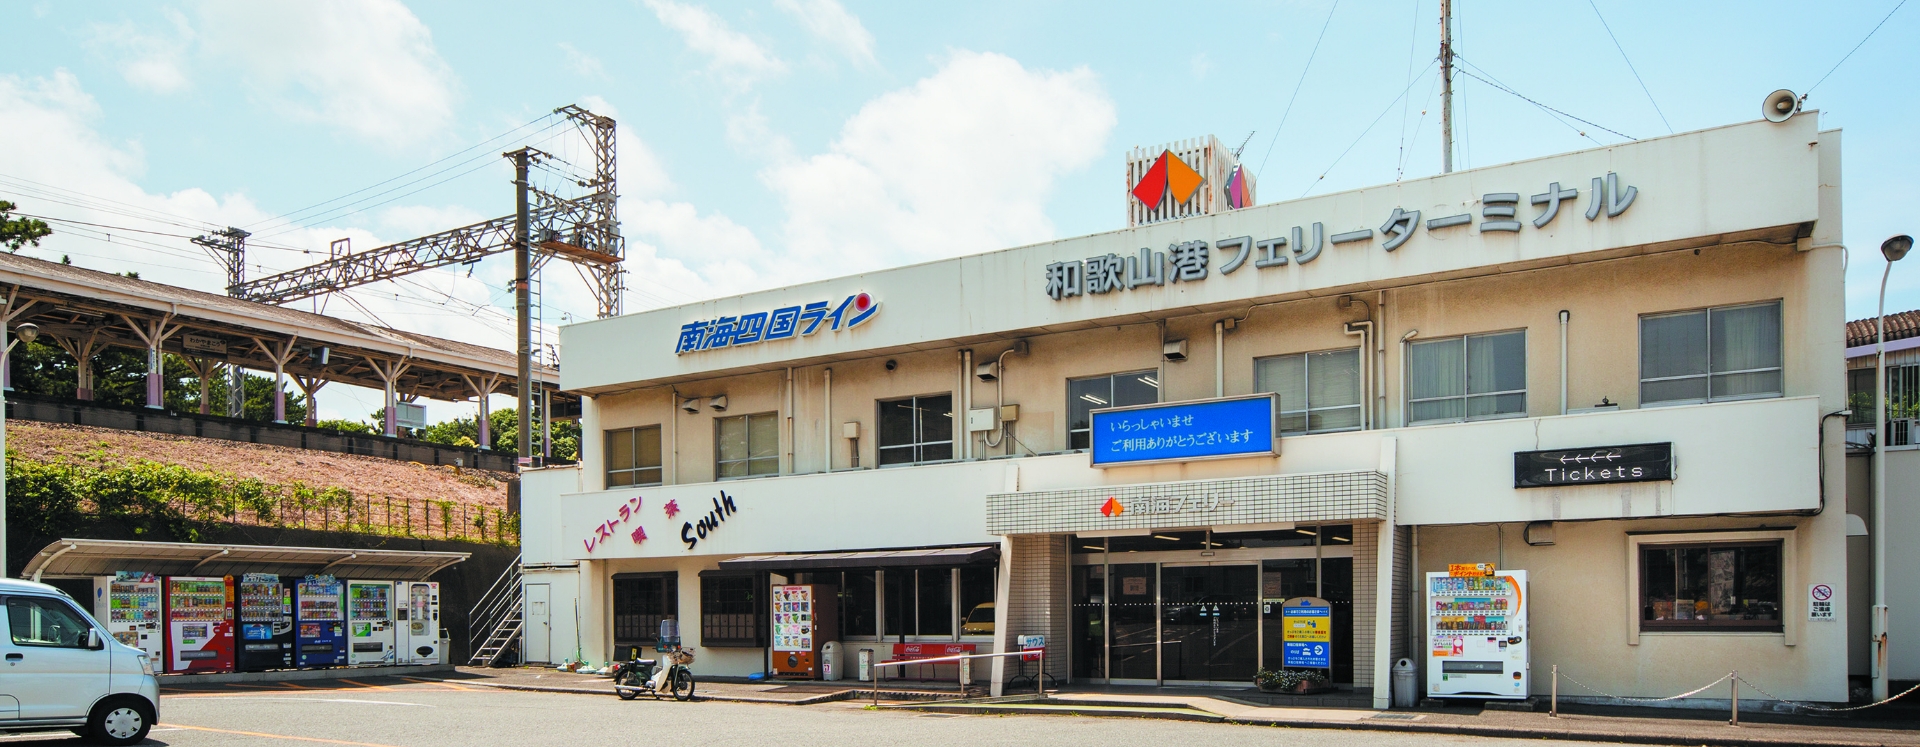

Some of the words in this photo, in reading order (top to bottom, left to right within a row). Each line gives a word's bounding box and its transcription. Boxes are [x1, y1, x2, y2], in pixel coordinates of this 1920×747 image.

[1045, 172, 1638, 301] 和歌山港フェリーターミナル
[675, 293, 882, 355] 南海四国ライン
[1110, 414, 1194, 432] いらっしゃいませ
[1111, 428, 1253, 452] ご利用ありがとうございます
[1545, 465, 1643, 482] Tickets
[1130, 492, 1236, 515] 南海フェリー
[583, 496, 642, 553] レストラン
[681, 489, 737, 550] South
[1026, 636, 1044, 647] サウス
